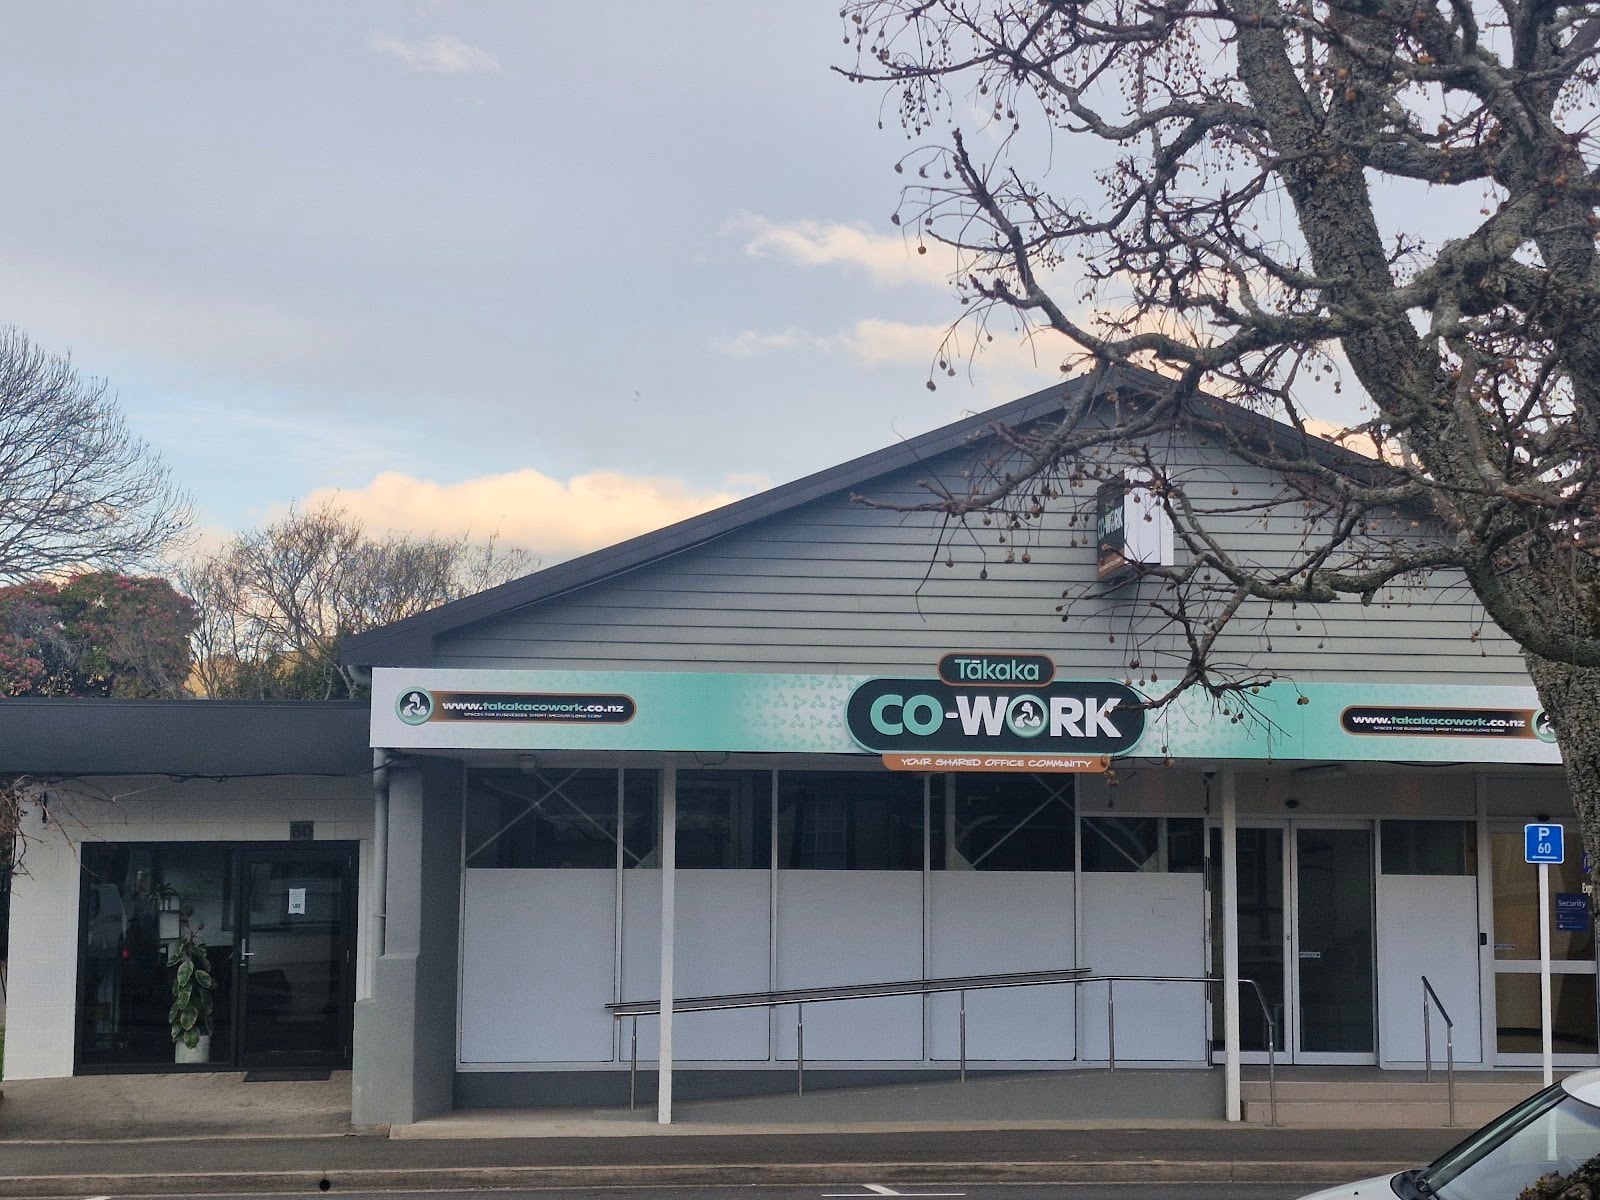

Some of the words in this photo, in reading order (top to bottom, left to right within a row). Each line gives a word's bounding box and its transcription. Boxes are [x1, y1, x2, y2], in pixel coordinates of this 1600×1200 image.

[954, 659, 1039, 681] Tākaka
[442, 702, 624, 713] www.takakacowork.co.nz
[870, 694, 1122, 738] CO-WORK
[1352, 716, 1526, 728] www.takakacowork.co.nz
[901, 758, 932, 766] YOUR
[935, 758, 981, 767] SHARED
[985, 759, 1024, 767] OFFICE
[1028, 759, 1092, 768] COMMUNITY
[1538, 828, 1550, 841] P
[1537, 843, 1551, 854] 60
[1557, 899, 1586, 909] Security
